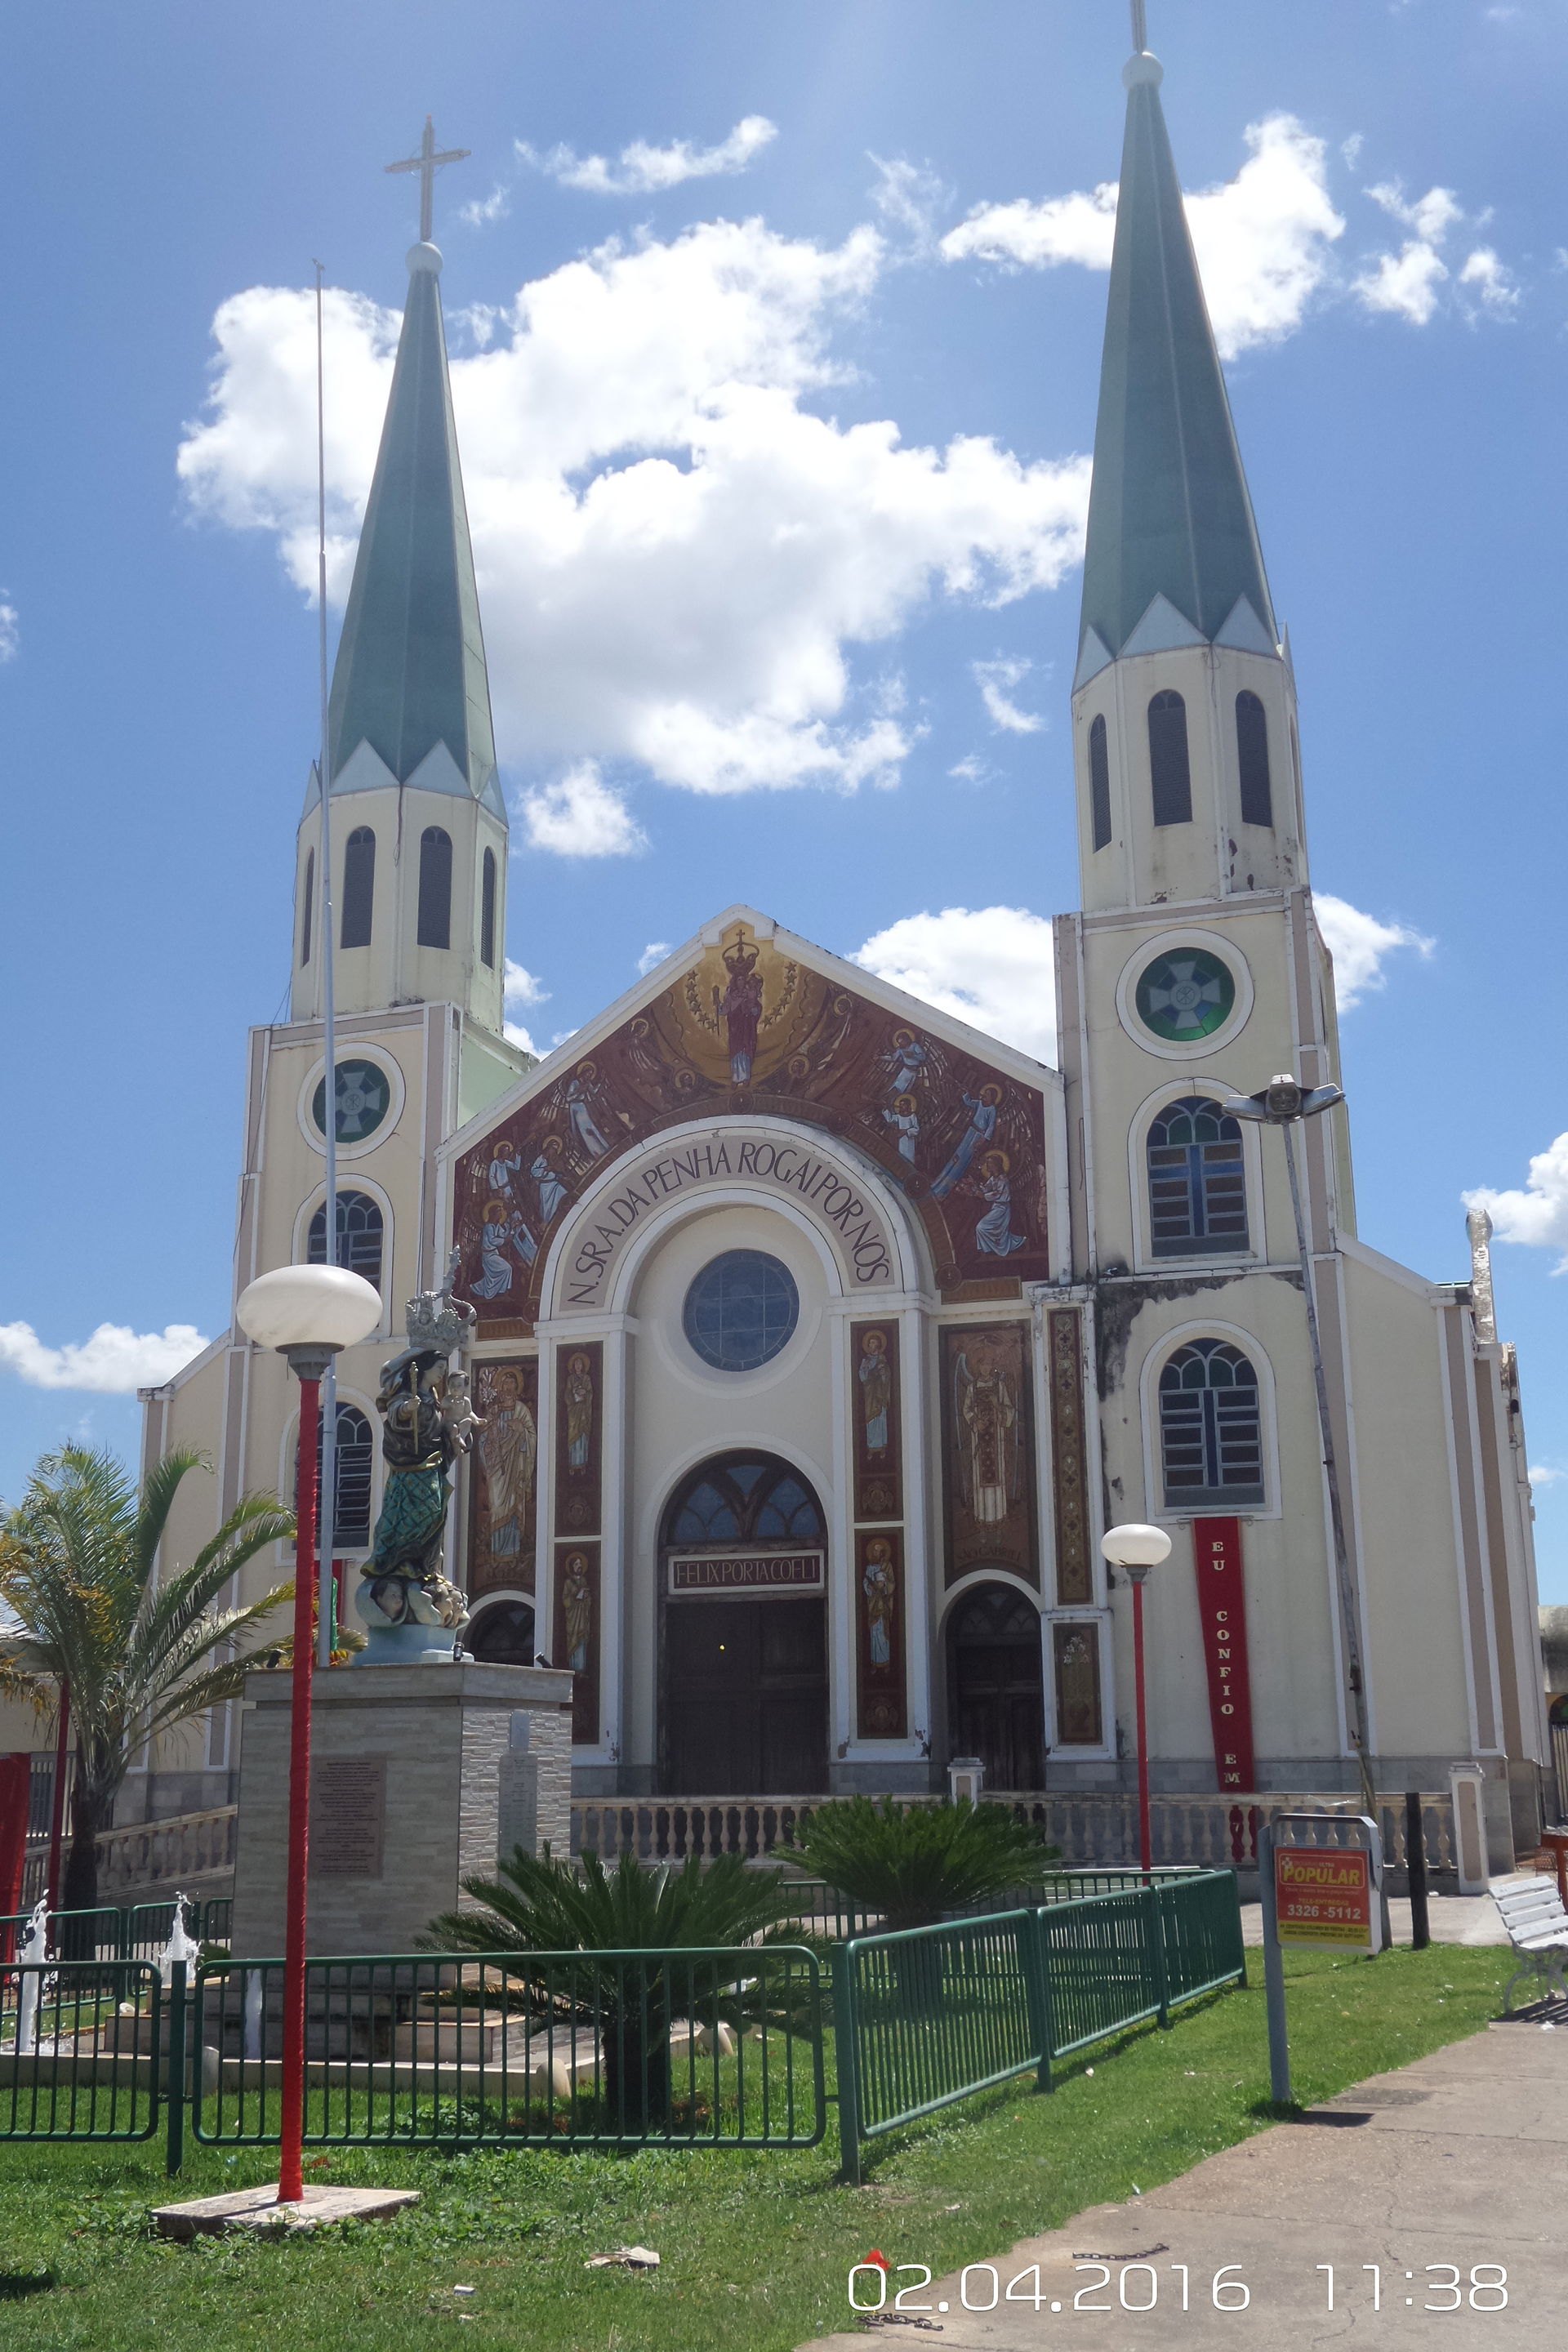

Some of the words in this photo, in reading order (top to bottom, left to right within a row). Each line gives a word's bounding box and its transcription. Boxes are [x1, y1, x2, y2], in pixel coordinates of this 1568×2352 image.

[608, 1187, 651, 1227] DA
[642, 1143, 731, 1200] PENHA
[738, 1143, 822, 1192] ROGAI
[810, 1172, 863, 1231] POR
[844, 1220, 889, 1281] NÓS
[1212, 1541, 1225, 1571] EU
[676, 1561, 719, 1584] FELIX
[721, 1560, 769, 1583] PORTA
[1216, 1610, 1234, 1715] CONFIO
[1224, 1753, 1240, 1784] EM
[1283, 1864, 1360, 1885] POPULAR
[1287, 1904, 1320, 1918] 3326
